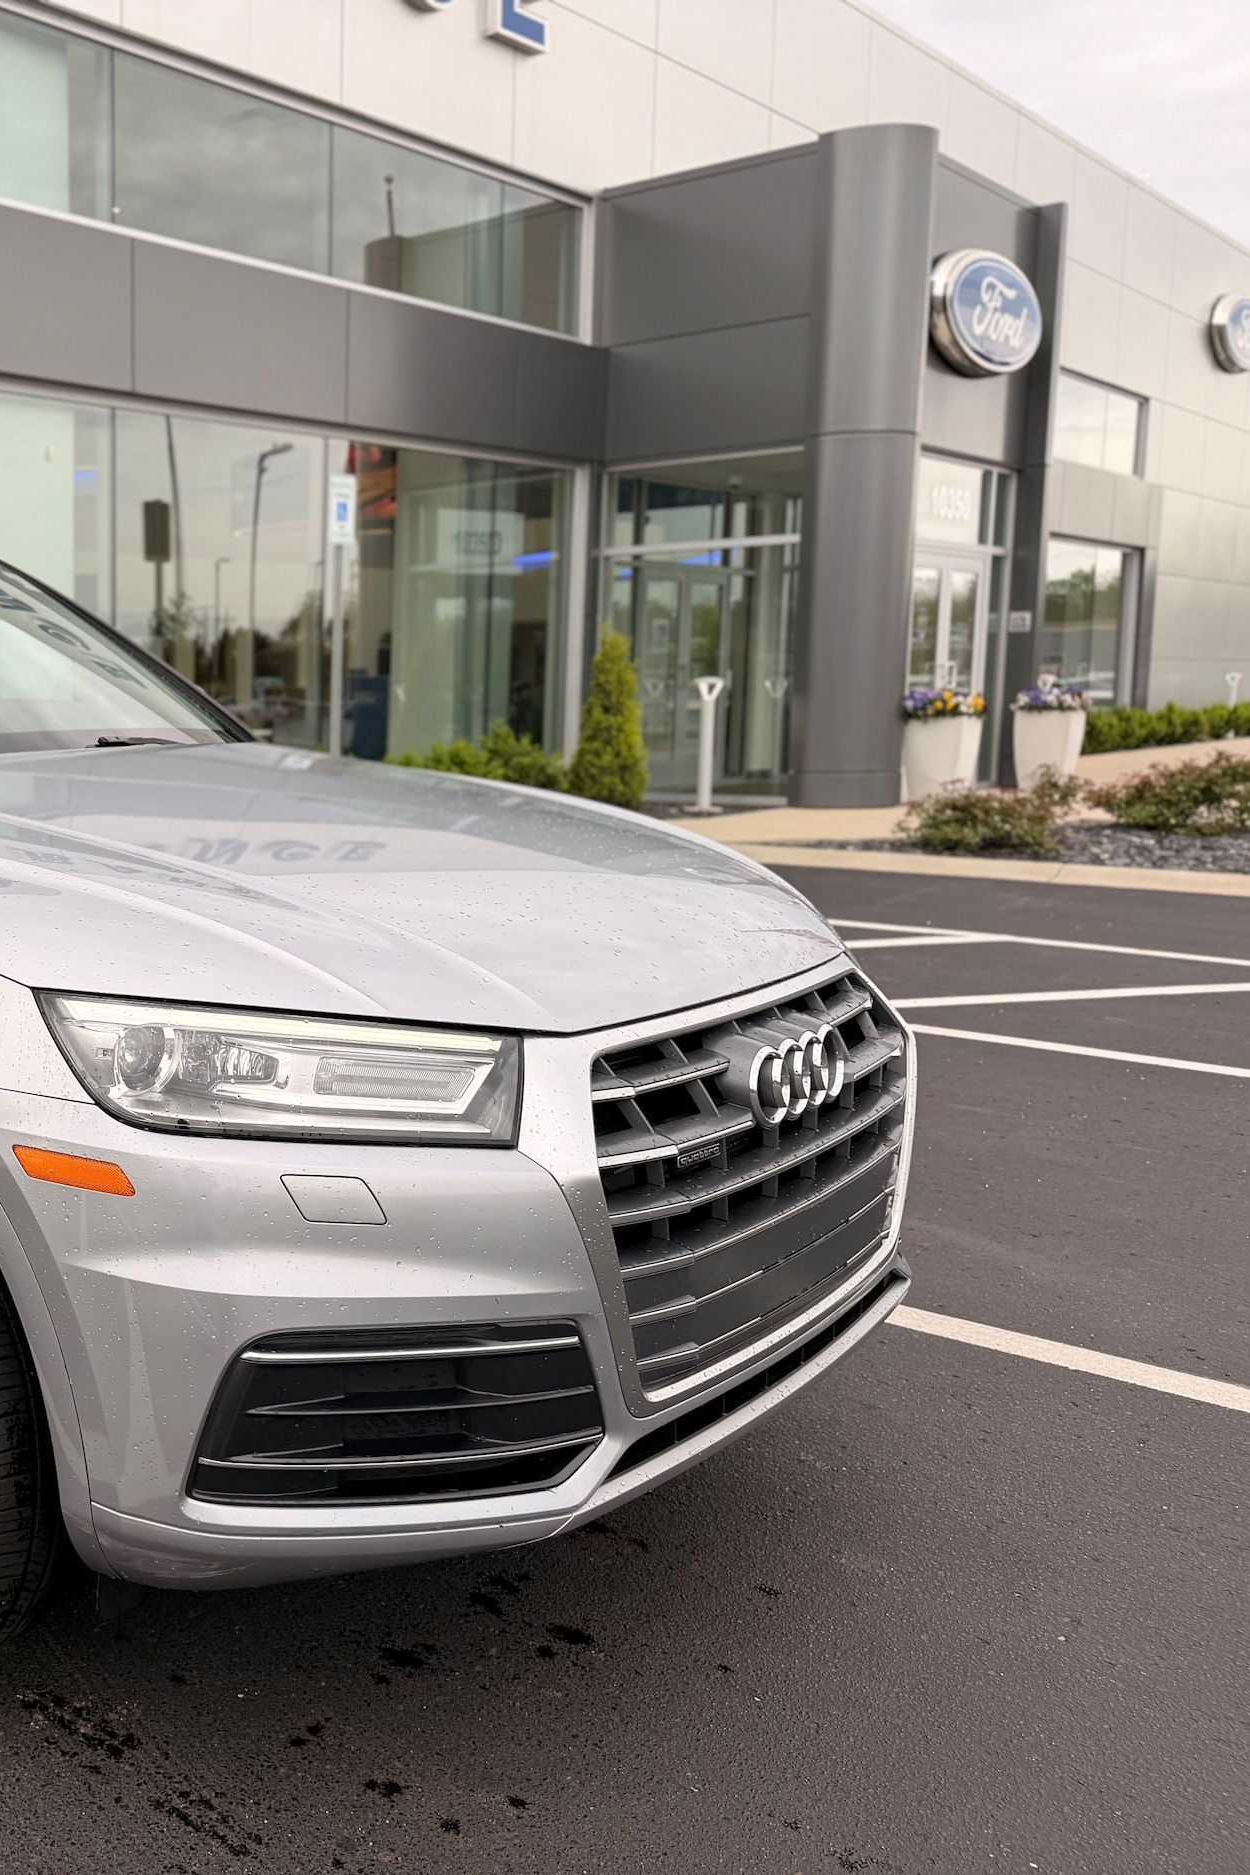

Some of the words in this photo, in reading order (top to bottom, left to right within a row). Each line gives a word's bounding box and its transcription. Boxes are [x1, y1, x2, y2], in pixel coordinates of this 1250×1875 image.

[973, 276, 1028, 349] Ford
[931, 483, 972, 522] 10350
[680, 1146, 720, 1166] quattro
